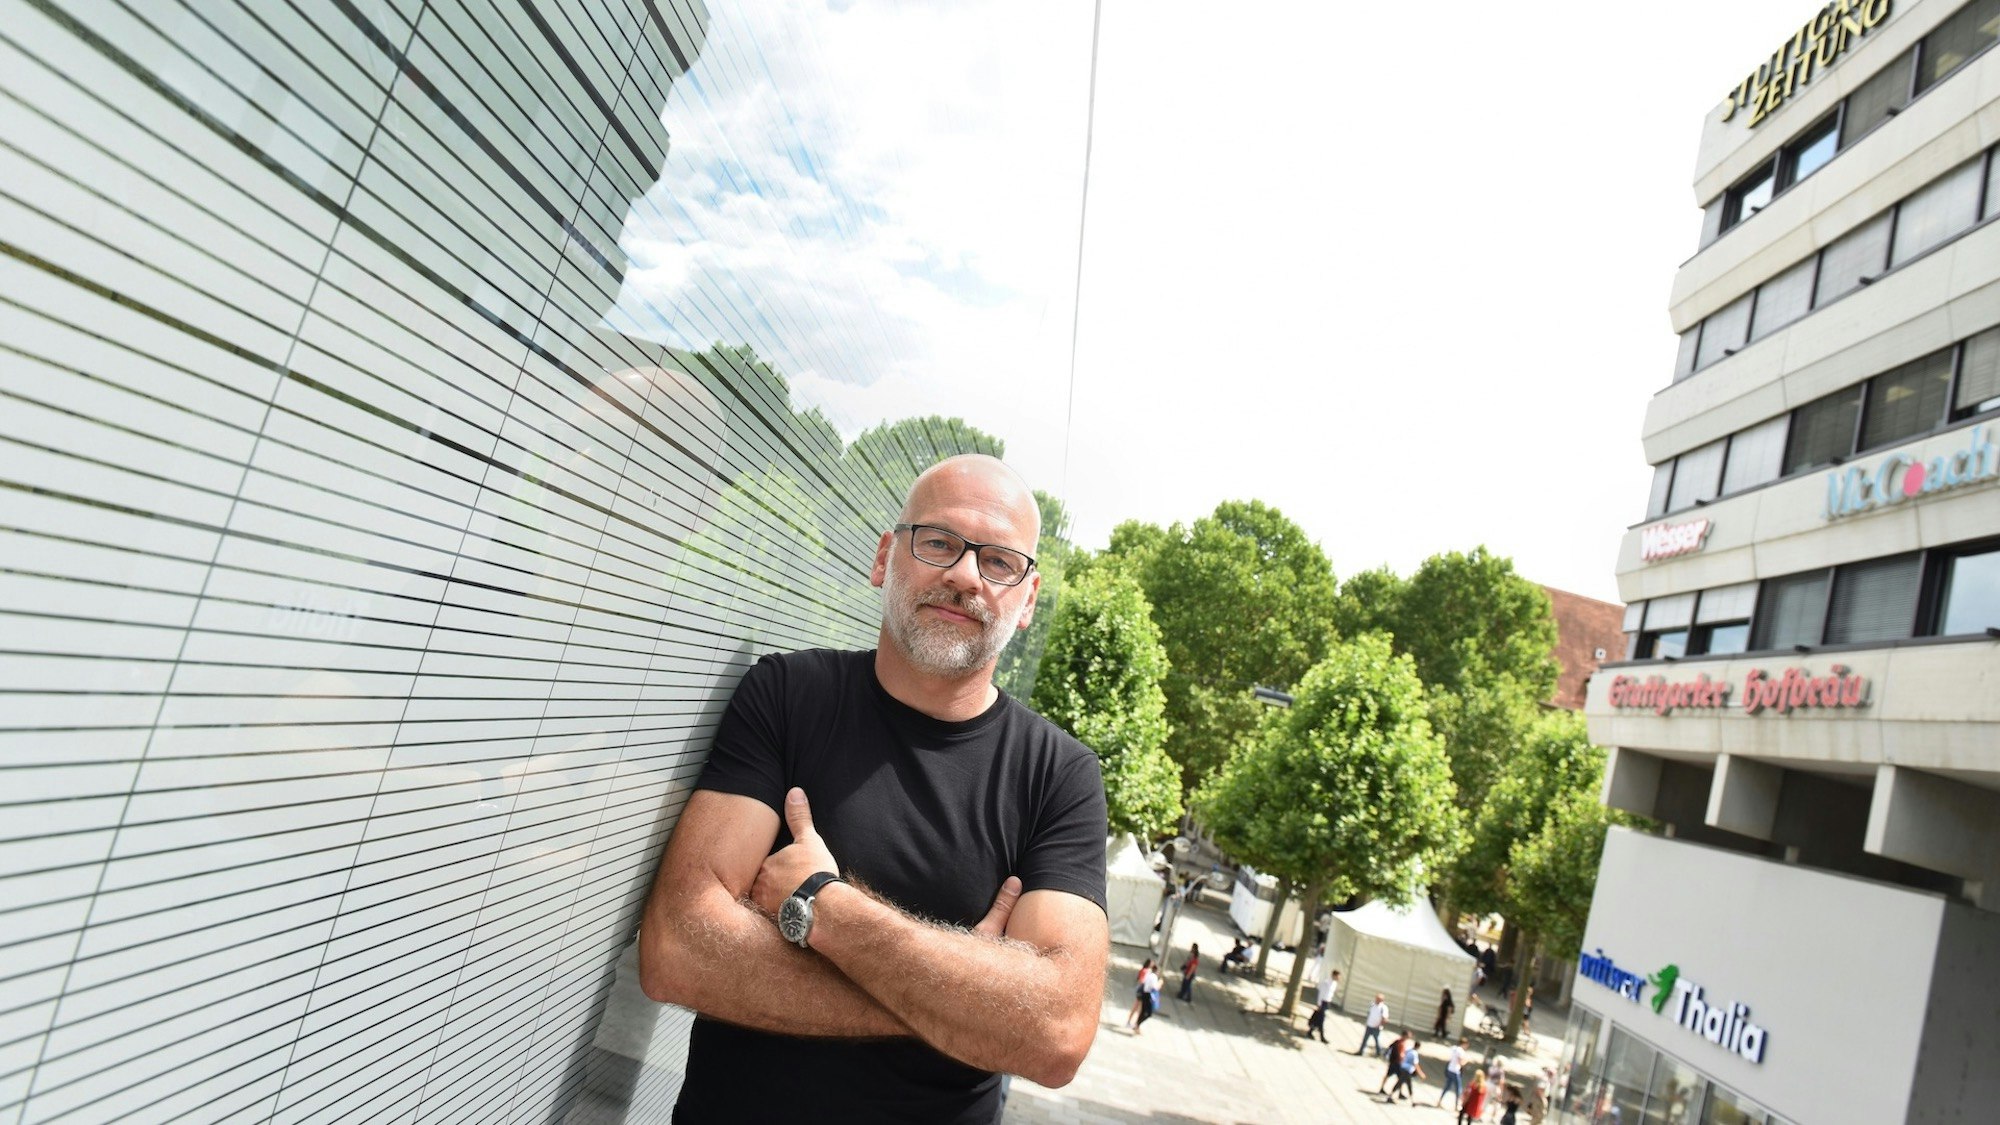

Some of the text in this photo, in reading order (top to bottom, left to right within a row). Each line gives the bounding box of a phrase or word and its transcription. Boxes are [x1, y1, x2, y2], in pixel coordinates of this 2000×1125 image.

[1748, 0, 1893, 129] ZEITUNG
[1608, 672, 1730, 717] Stuttgarter
[1673, 976, 1768, 1064] Thalia
